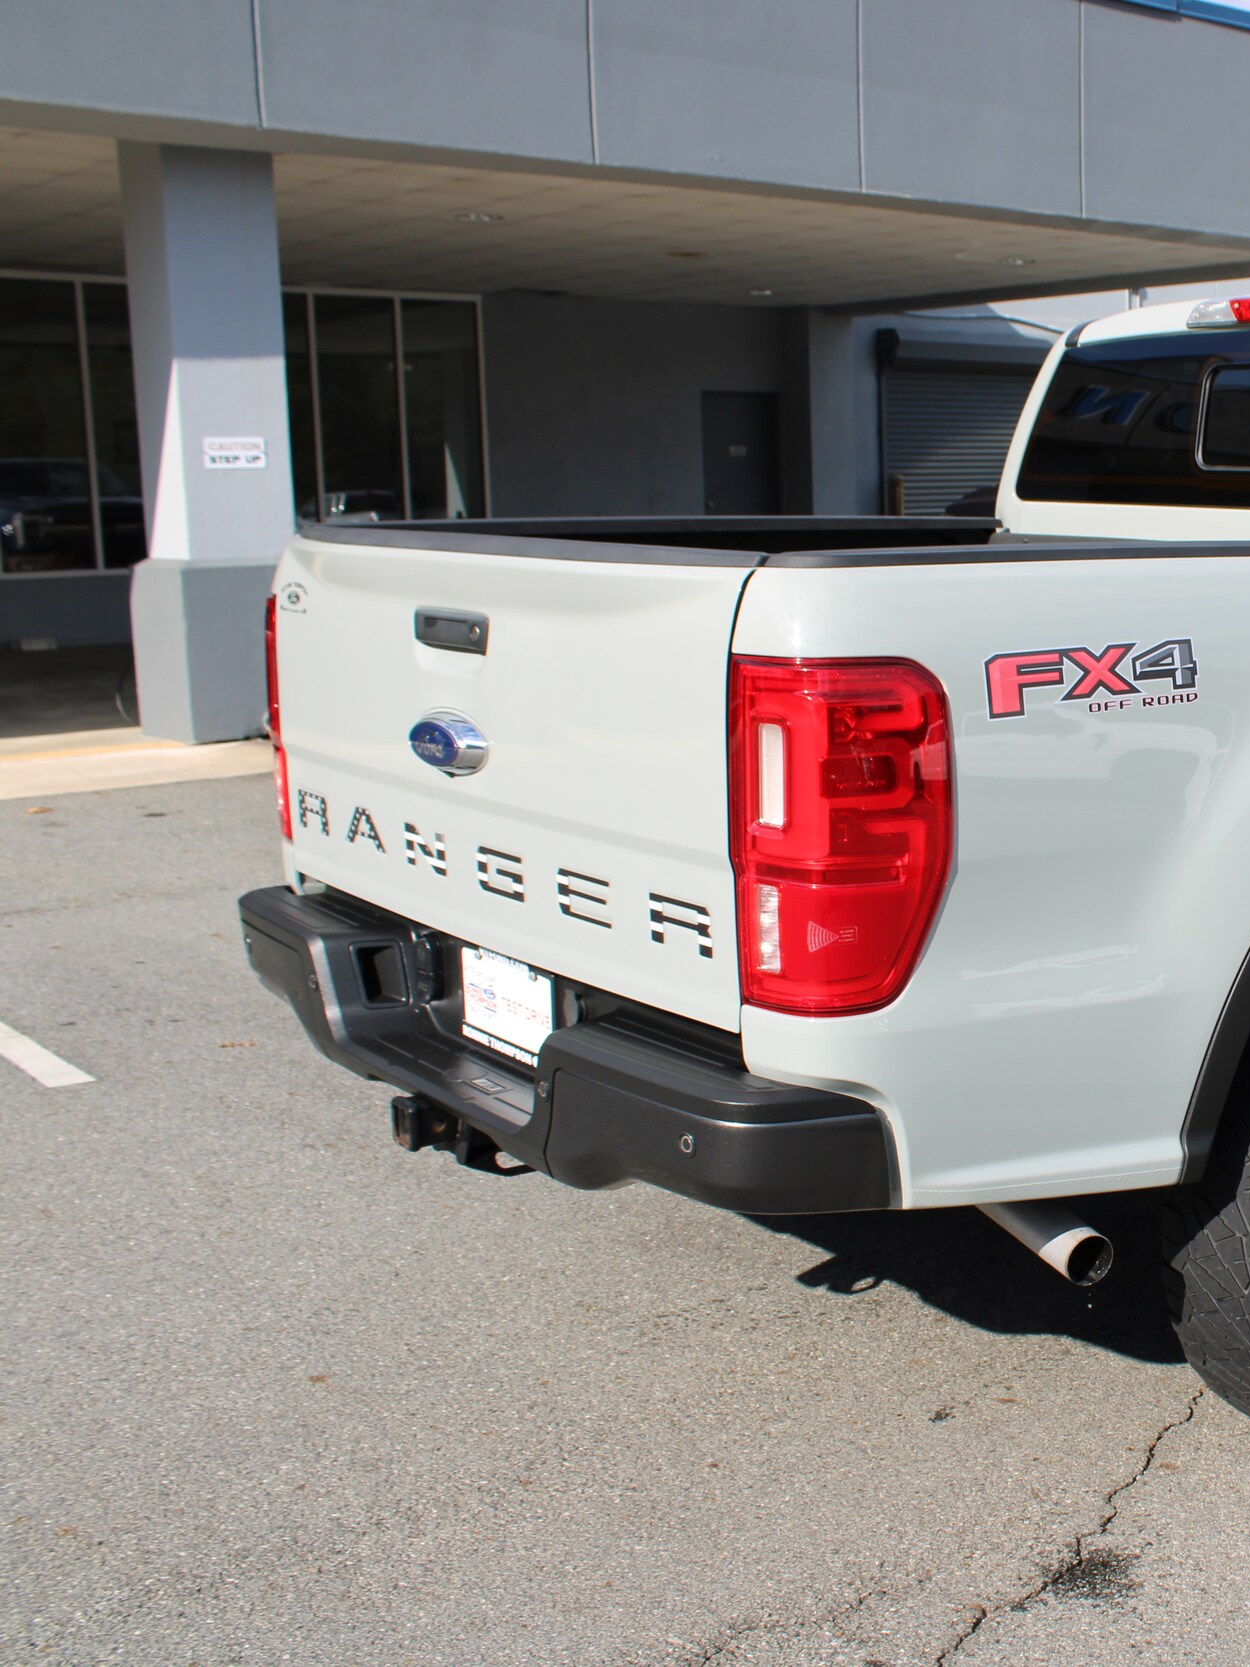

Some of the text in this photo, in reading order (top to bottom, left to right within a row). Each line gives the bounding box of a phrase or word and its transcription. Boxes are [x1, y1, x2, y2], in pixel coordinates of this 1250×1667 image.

[208, 441, 262, 451] CAUTION
[209, 455, 262, 465] STEP UP
[984, 637, 1199, 721] FX4
[1089, 692, 1199, 713] OFF ROAD
[297, 788, 714, 960] RANGER
[501, 996, 523, 1017] TEST
[525, 1006, 551, 1029] DRIVE
